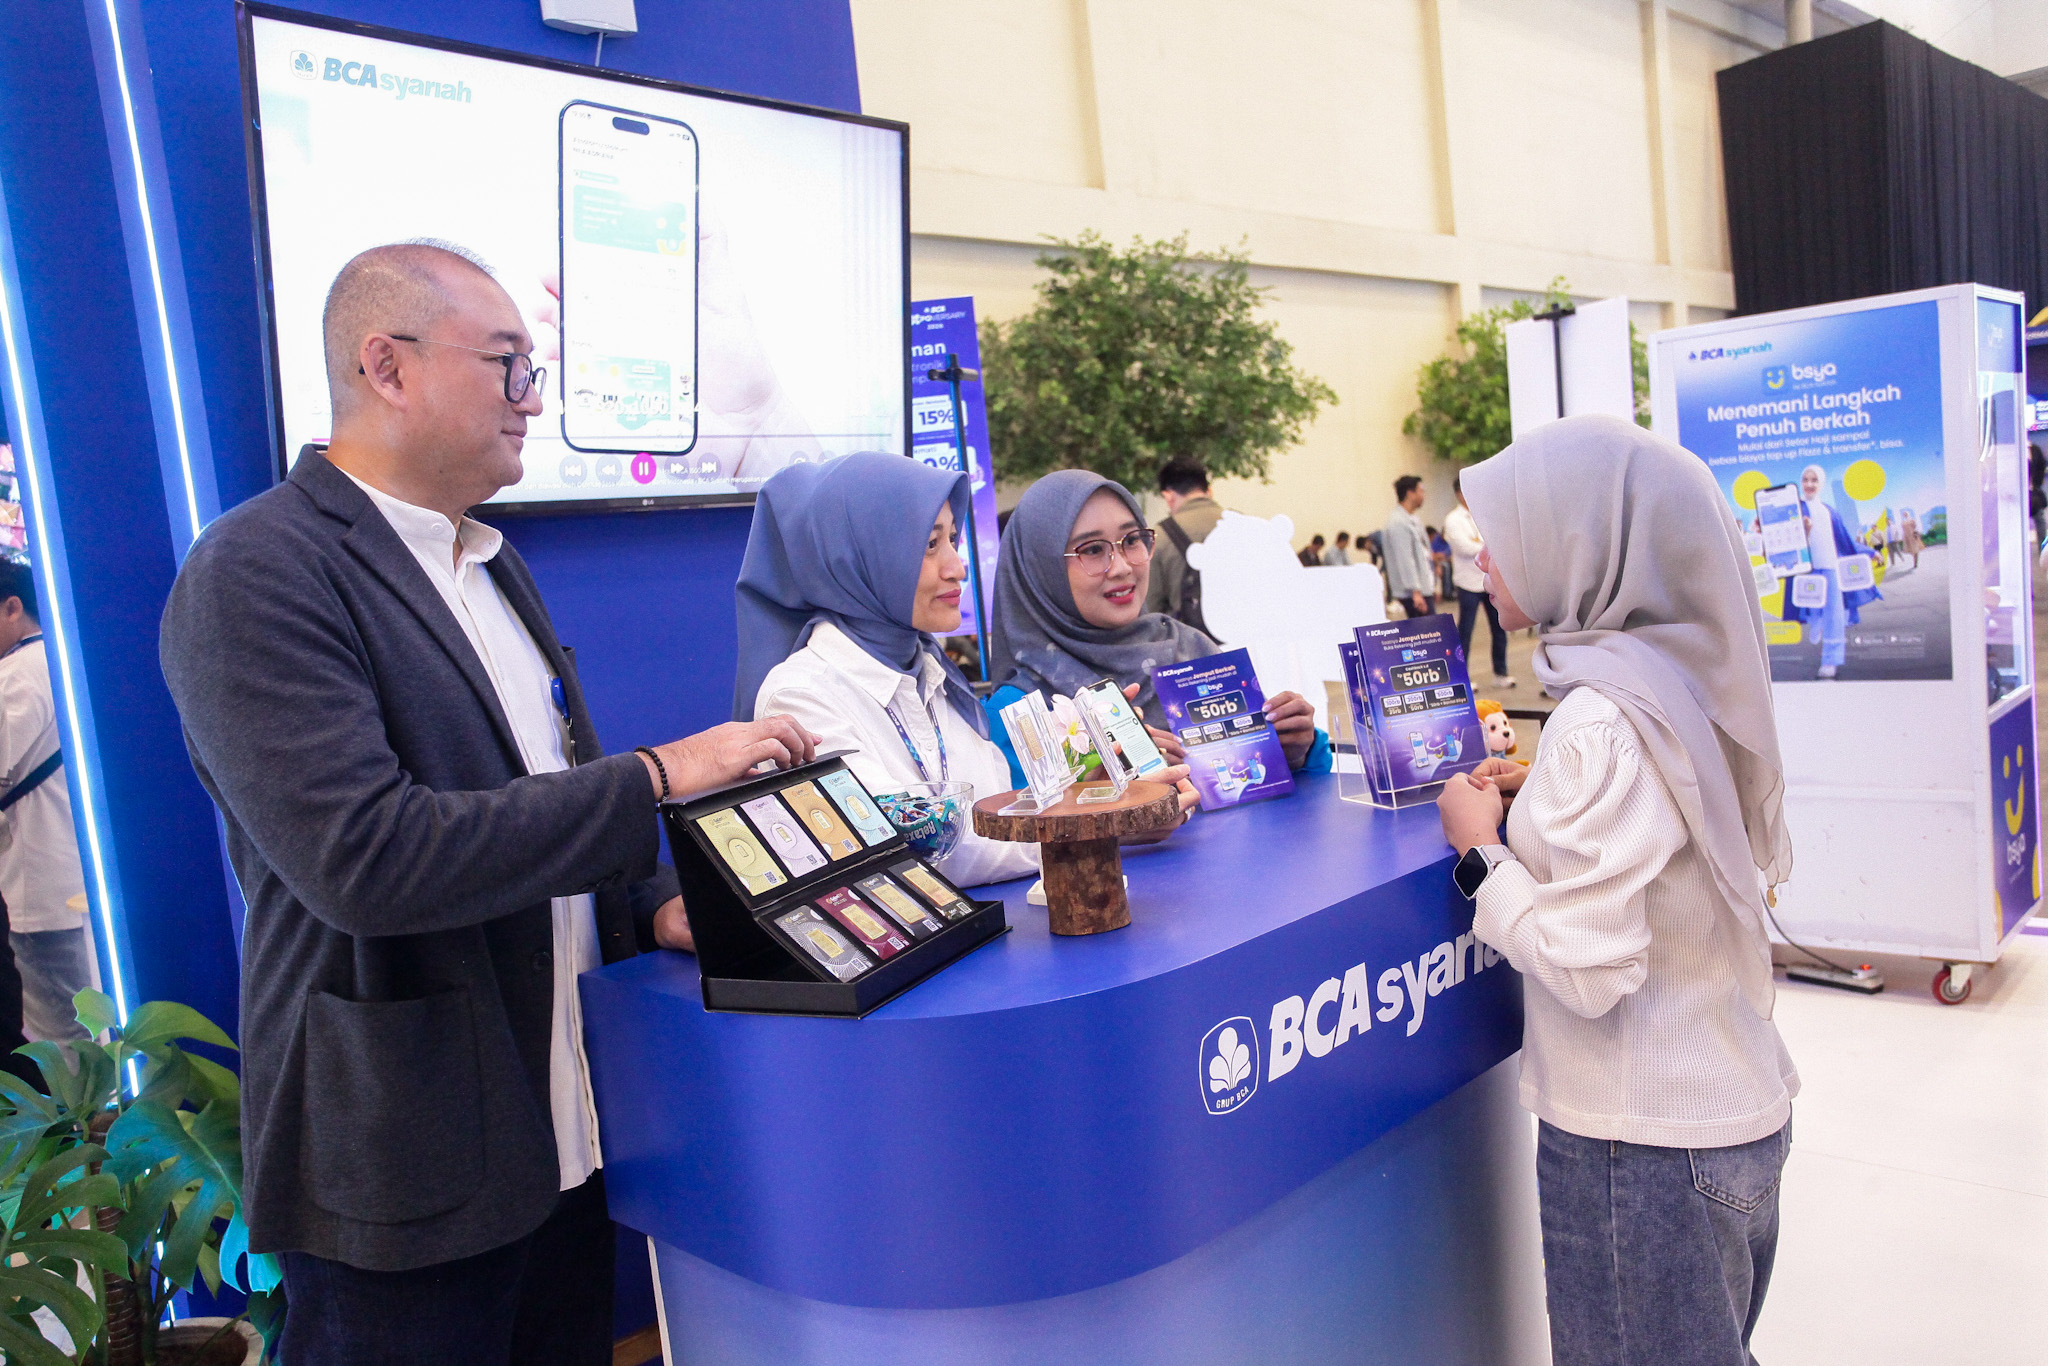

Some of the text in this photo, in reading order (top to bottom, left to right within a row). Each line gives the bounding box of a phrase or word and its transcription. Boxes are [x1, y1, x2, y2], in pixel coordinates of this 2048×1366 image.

[323, 57, 472, 103] BCA syariah
[1791, 363, 1837, 382] bsya
[1707, 384, 1901, 422] Menemani Langkah
[1736, 410, 1871, 439] Penuh Berkah
[1399, 634, 1420, 643] Jemput
[1420, 631, 1441, 639] Berkah
[1193, 670, 1215, 680] Jemput
[1215, 664, 1236, 674] Berkah
[1268, 929, 1509, 1082] BCA syaria
[1216, 1085, 1250, 1109] GRUP BCA
